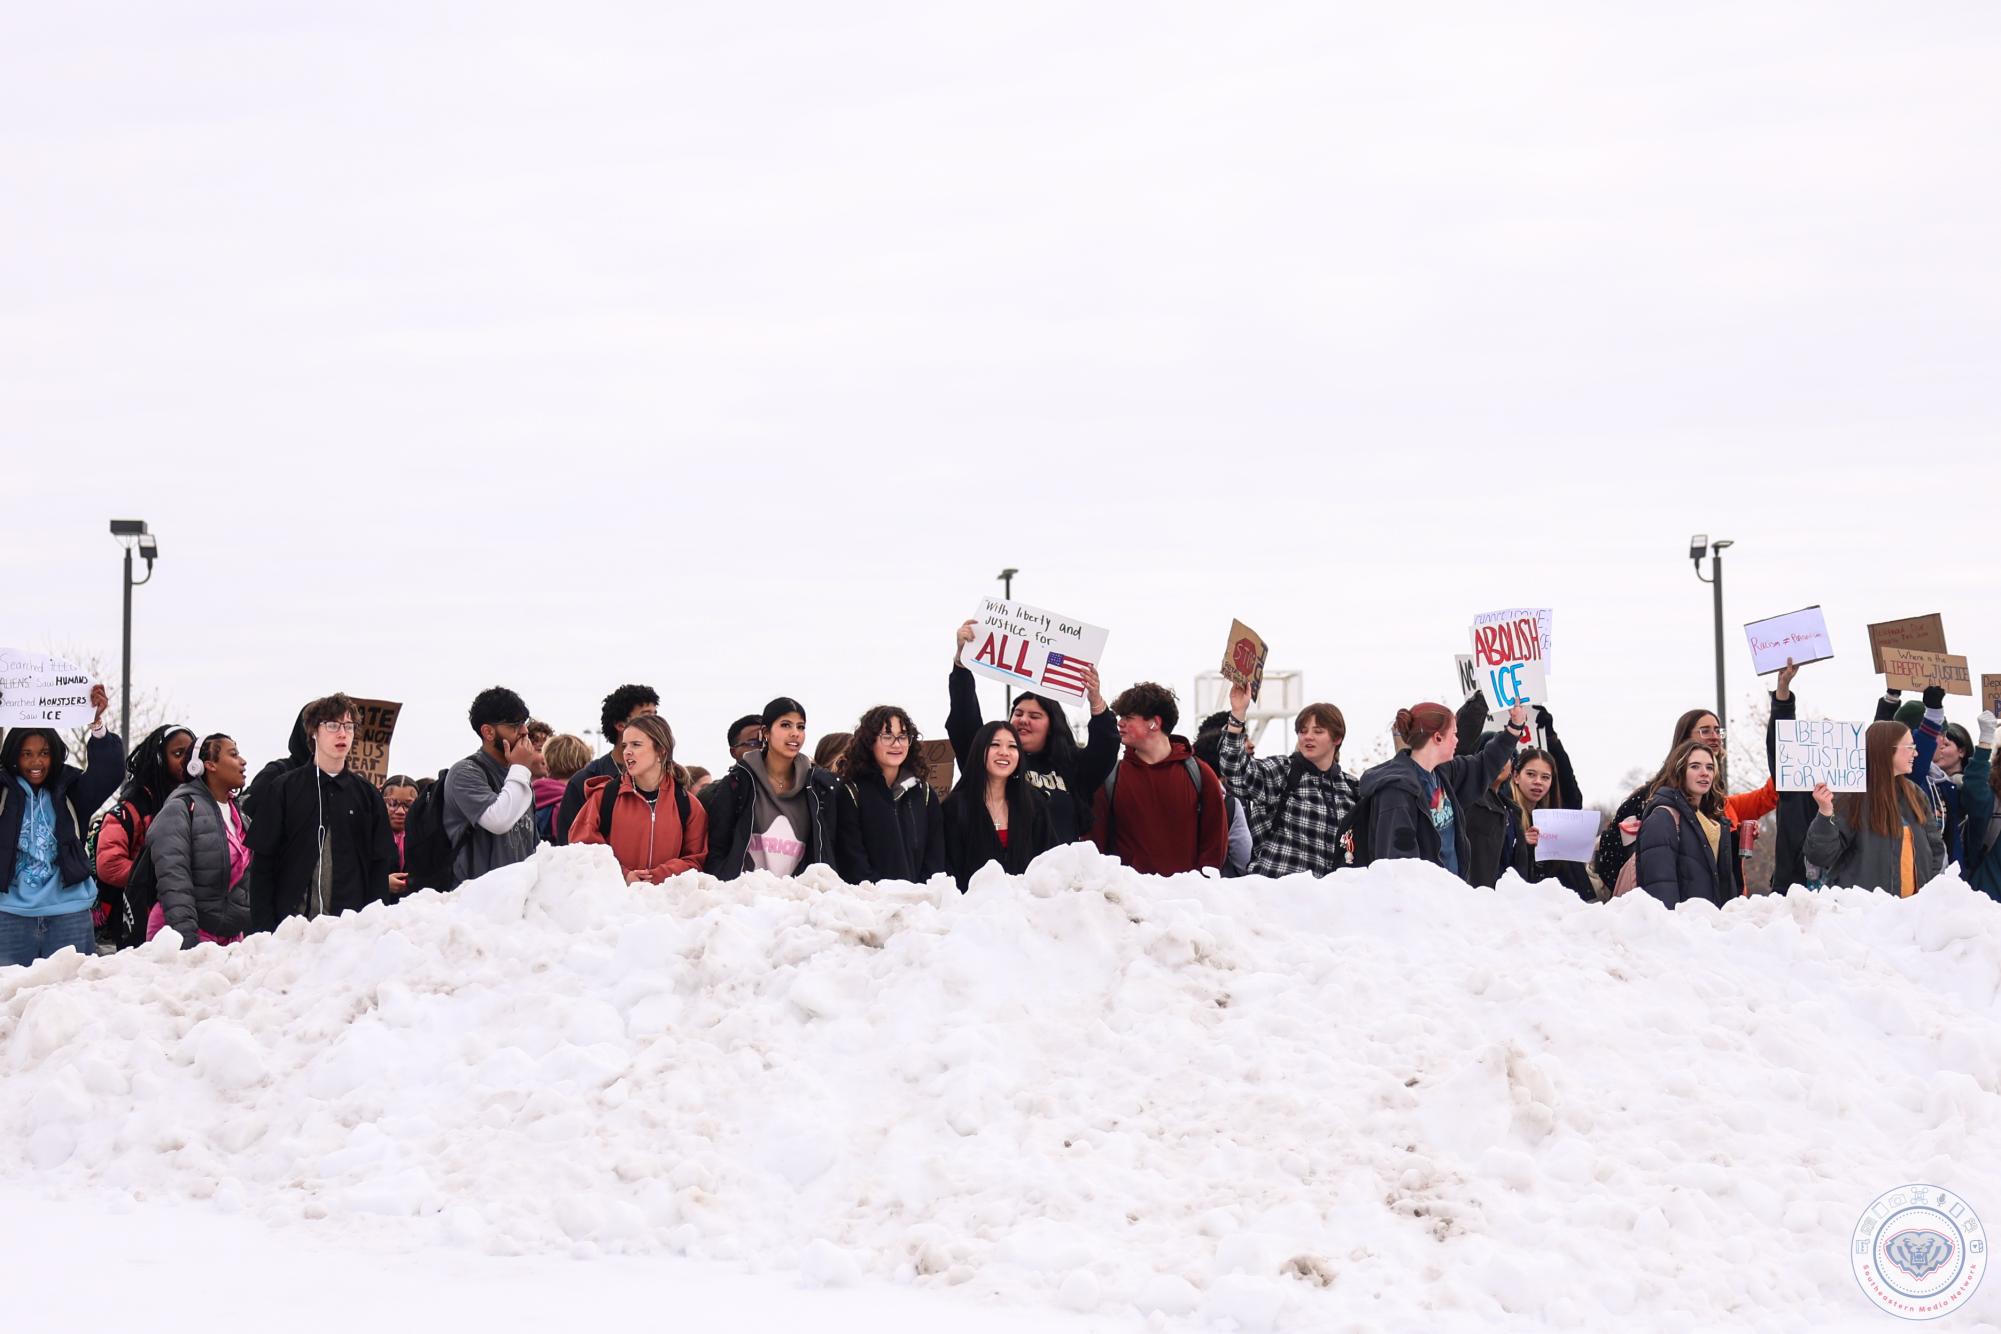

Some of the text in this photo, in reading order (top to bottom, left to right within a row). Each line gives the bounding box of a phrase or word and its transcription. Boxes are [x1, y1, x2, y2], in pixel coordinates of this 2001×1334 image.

[1016, 606, 1051, 632] liberty
[1059, 623, 1082, 640] and
[1035, 631, 1057, 646] for
[1474, 617, 1542, 668] ABOLISH
[975, 631, 1033, 678] ALL
[1490, 662, 1530, 708] ICE
[42, 711, 62, 720] ICE
[1777, 720, 1863, 749] LIBERTY
[363, 742, 384, 758] US
[1797, 743, 1866, 770] JUSTICE
[1781, 765, 1864, 788] FOR WHO?
